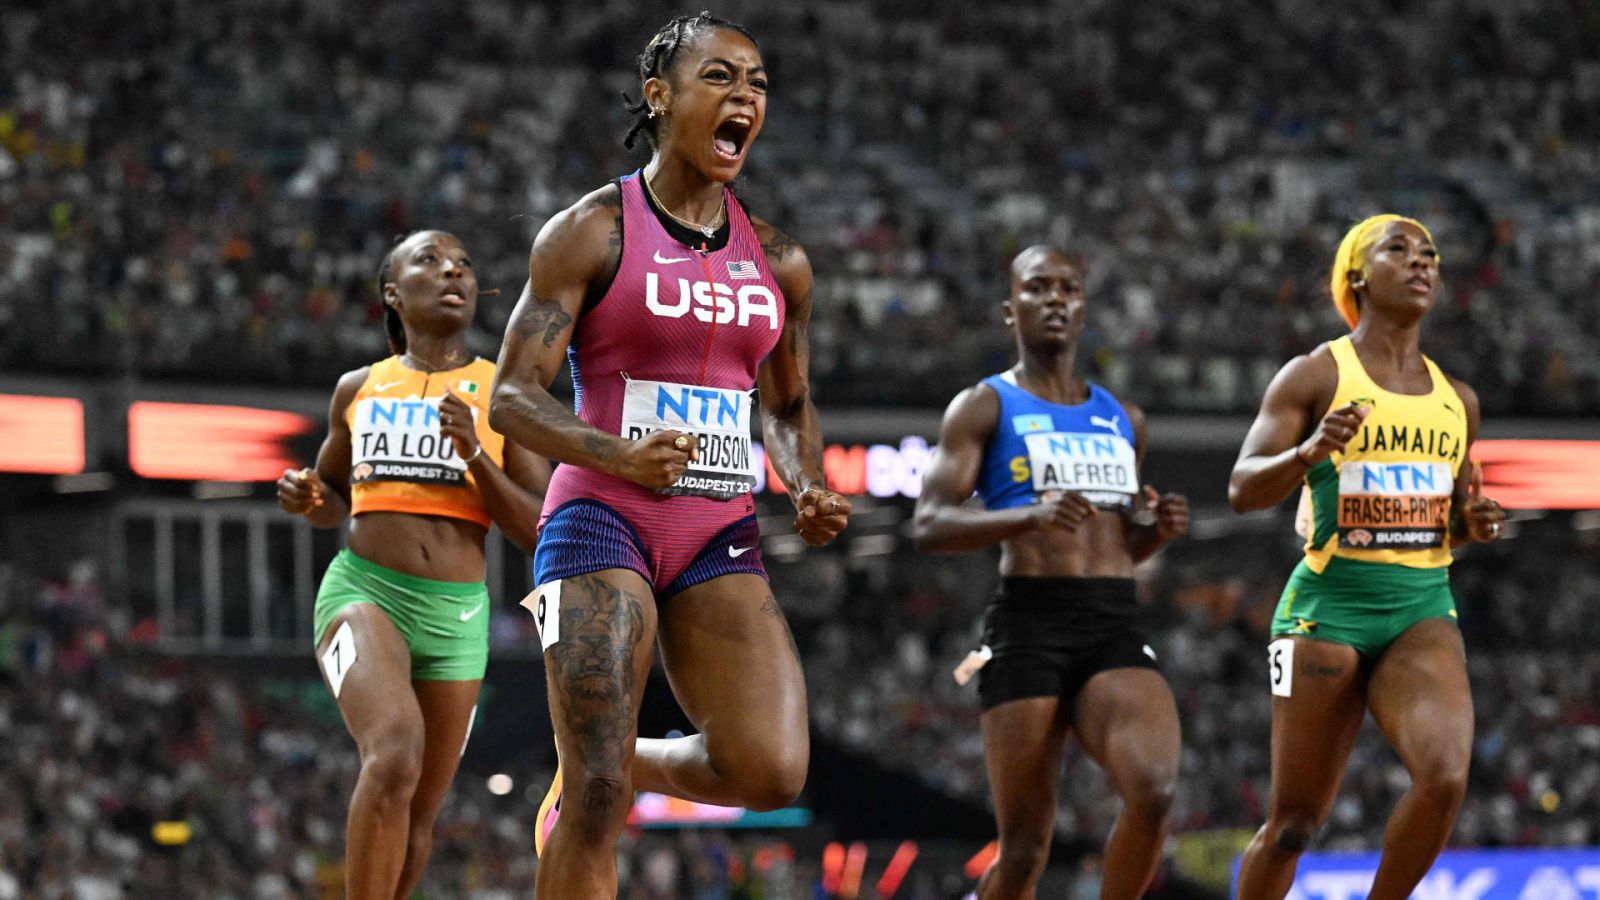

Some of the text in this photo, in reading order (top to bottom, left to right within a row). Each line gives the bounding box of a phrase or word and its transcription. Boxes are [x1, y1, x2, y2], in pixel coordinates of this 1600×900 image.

[646, 272, 779, 330] USA
[656, 384, 740, 429] NTN
[361, 432, 454, 461] TA LOU
[629, 426, 750, 470] RDSON
[1047, 436, 1116, 458] NTN
[1359, 425, 1460, 462] JAMAICA
[375, 463, 461, 481] BUDAPEST 23
[1009, 456, 1031, 483] S
[1043, 462, 1128, 487] ALFRED
[1362, 464, 1435, 491] NTN
[736, 481, 750, 494] 23
[538, 593, 547, 641] 9
[1273, 649, 1283, 685] 5
